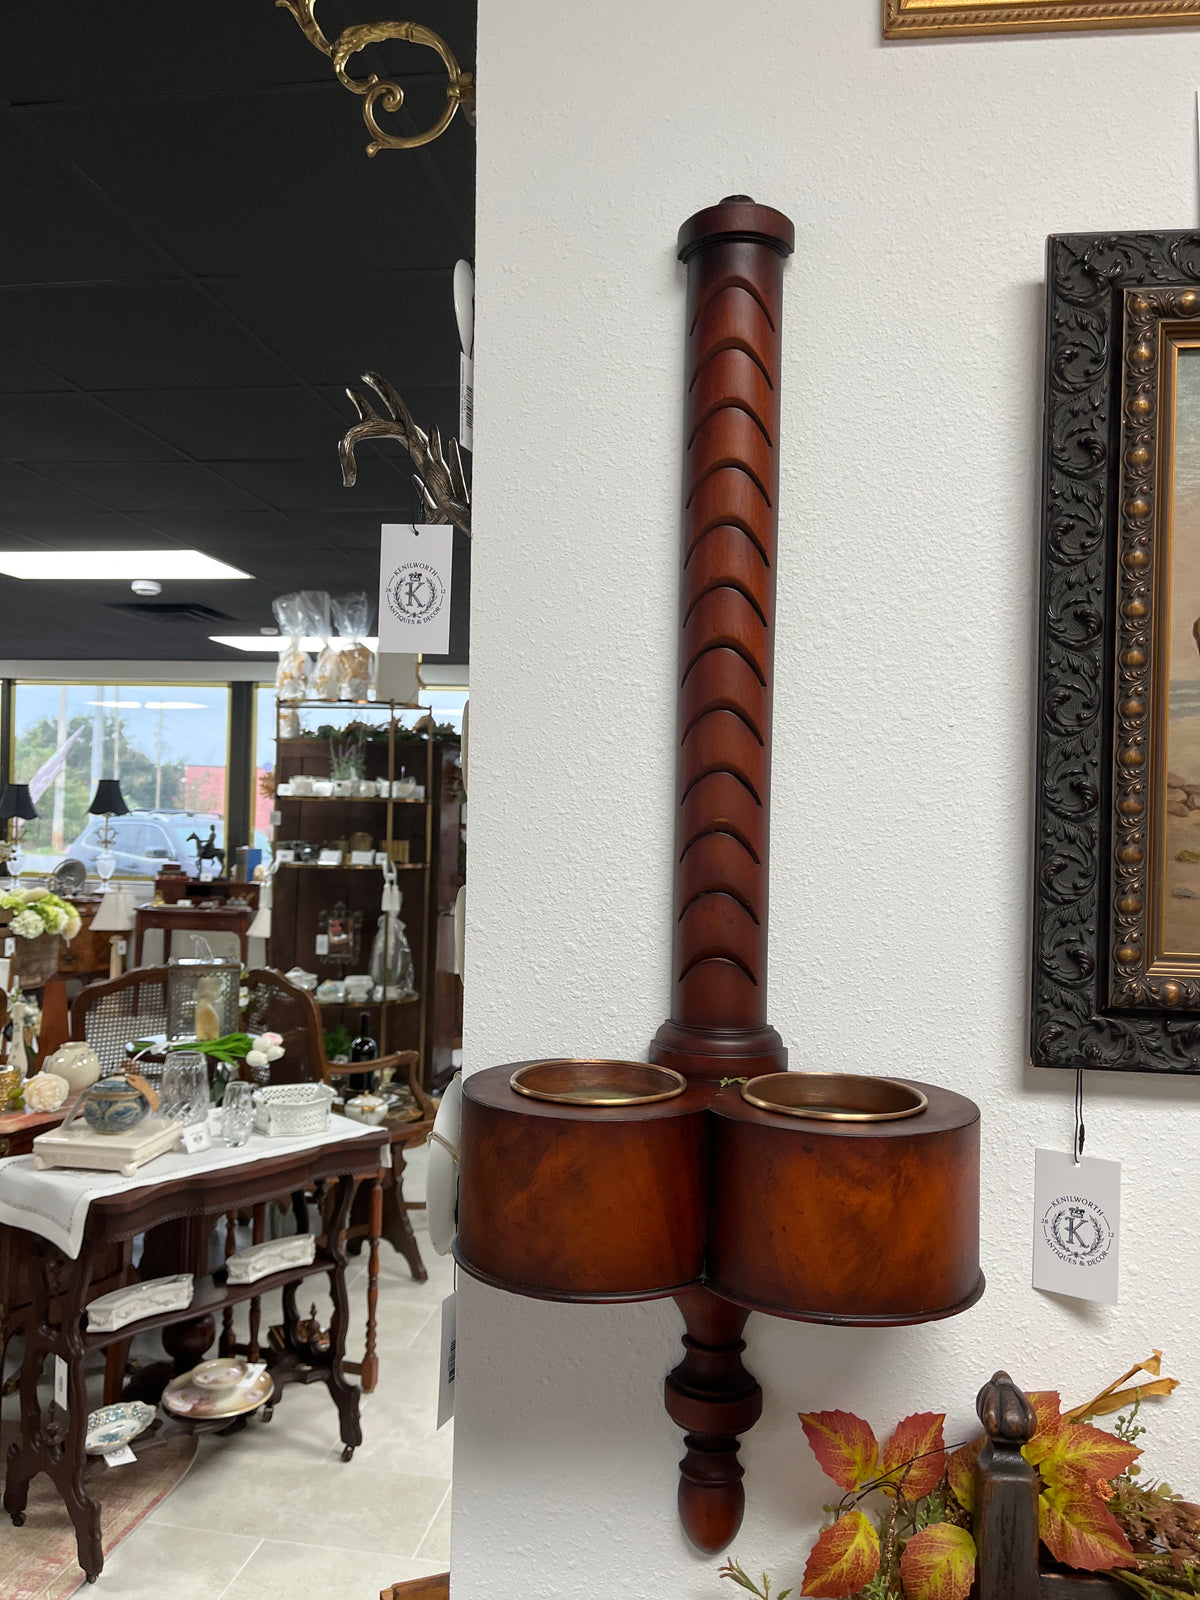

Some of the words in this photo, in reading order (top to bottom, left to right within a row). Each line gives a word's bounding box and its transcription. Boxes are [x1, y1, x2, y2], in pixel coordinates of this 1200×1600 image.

[393, 562, 438, 576] KENILWORTH
[405, 581, 425, 607] K
[389, 605, 415, 624] ANTIQUES
[422, 606, 441, 624] DECOR
[1050, 1195, 1104, 1216] KENILWORTH
[1064, 1216, 1090, 1248] K
[1045, 1239, 1077, 1265] ANTIQUES
[1087, 1250, 1108, 1267] DECOR
